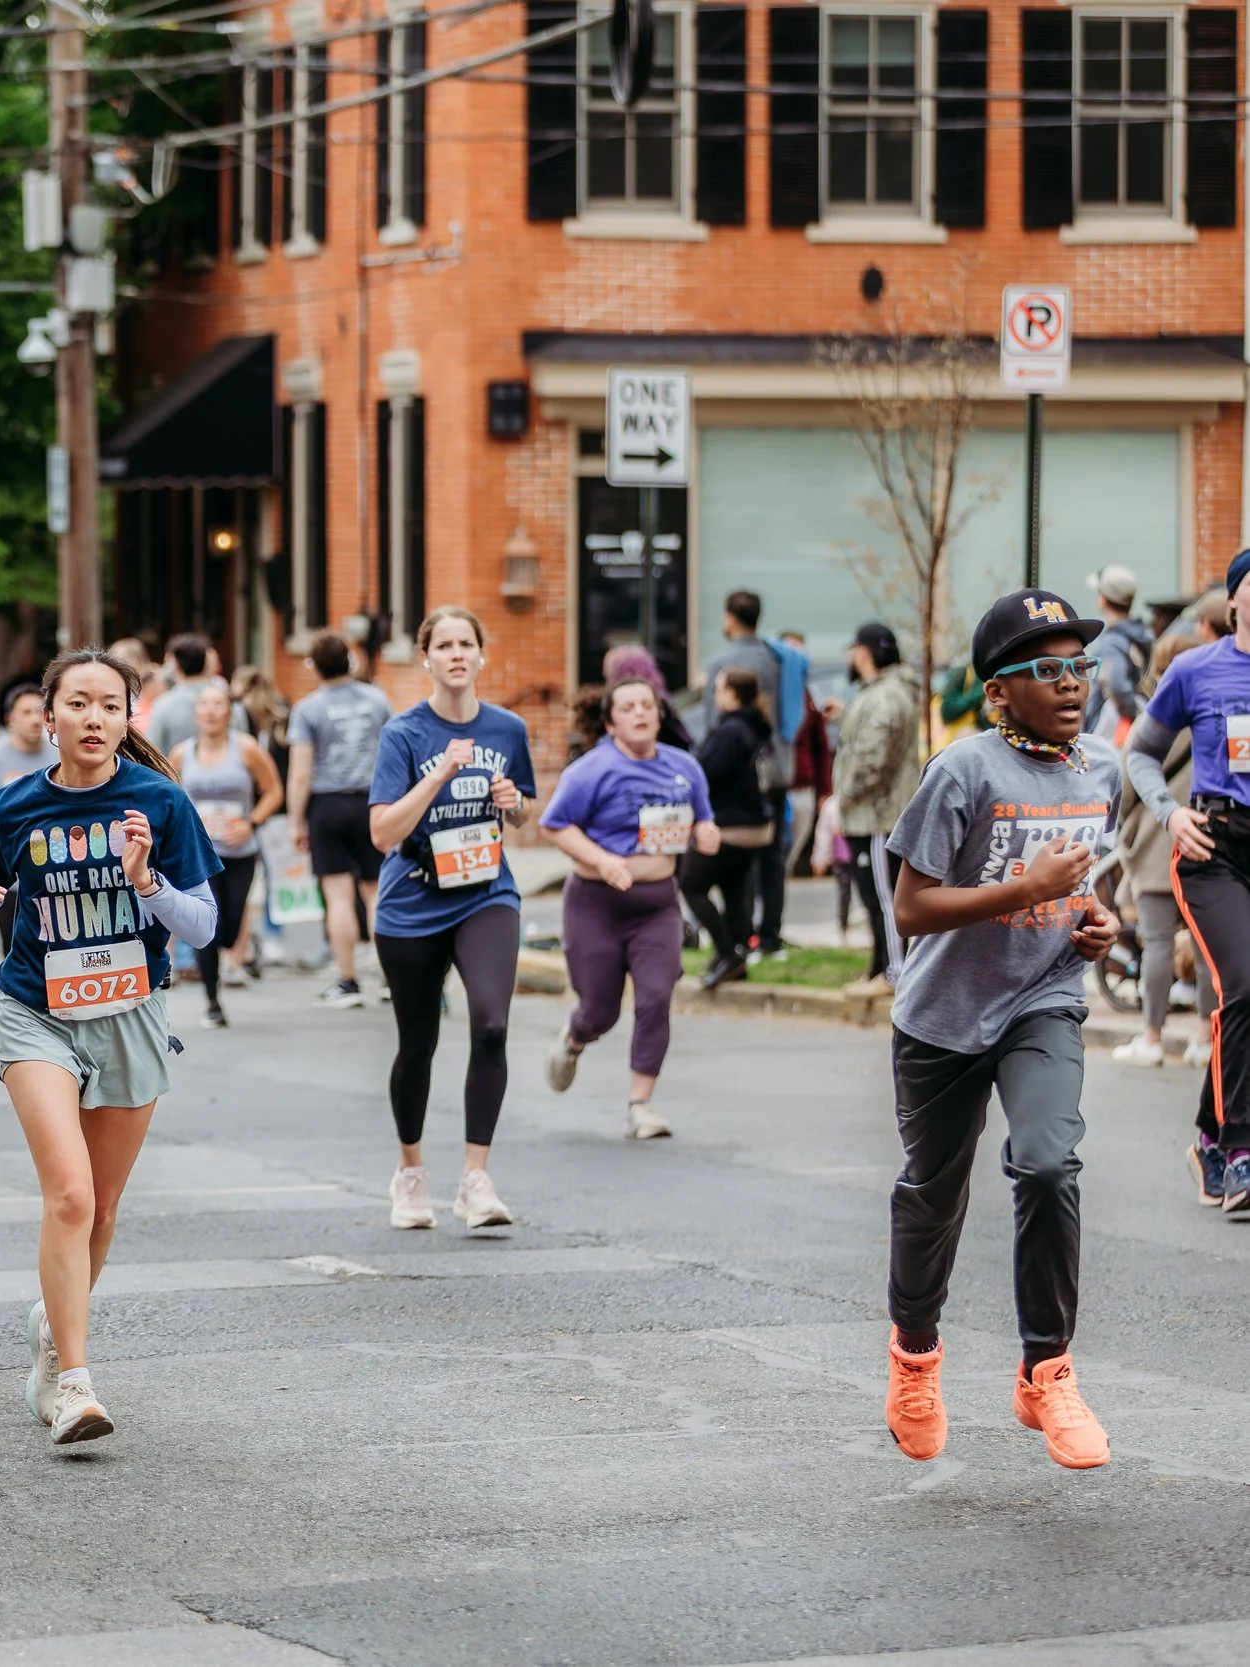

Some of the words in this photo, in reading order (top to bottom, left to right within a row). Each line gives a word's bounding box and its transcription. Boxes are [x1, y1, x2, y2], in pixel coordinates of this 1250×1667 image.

[618, 380, 679, 406] ONE
[620, 411, 680, 436] WAY
[1023, 597, 1068, 622] LM
[456, 781, 485, 796] 1994
[429, 801, 483, 823] ATHLETIC
[993, 803, 1017, 818] 28
[1020, 803, 1059, 817] Years
[1061, 799, 1108, 816] Runnin
[453, 847, 493, 871] 134
[44, 870, 80, 893] ONE
[60, 973, 138, 1004] 6072
